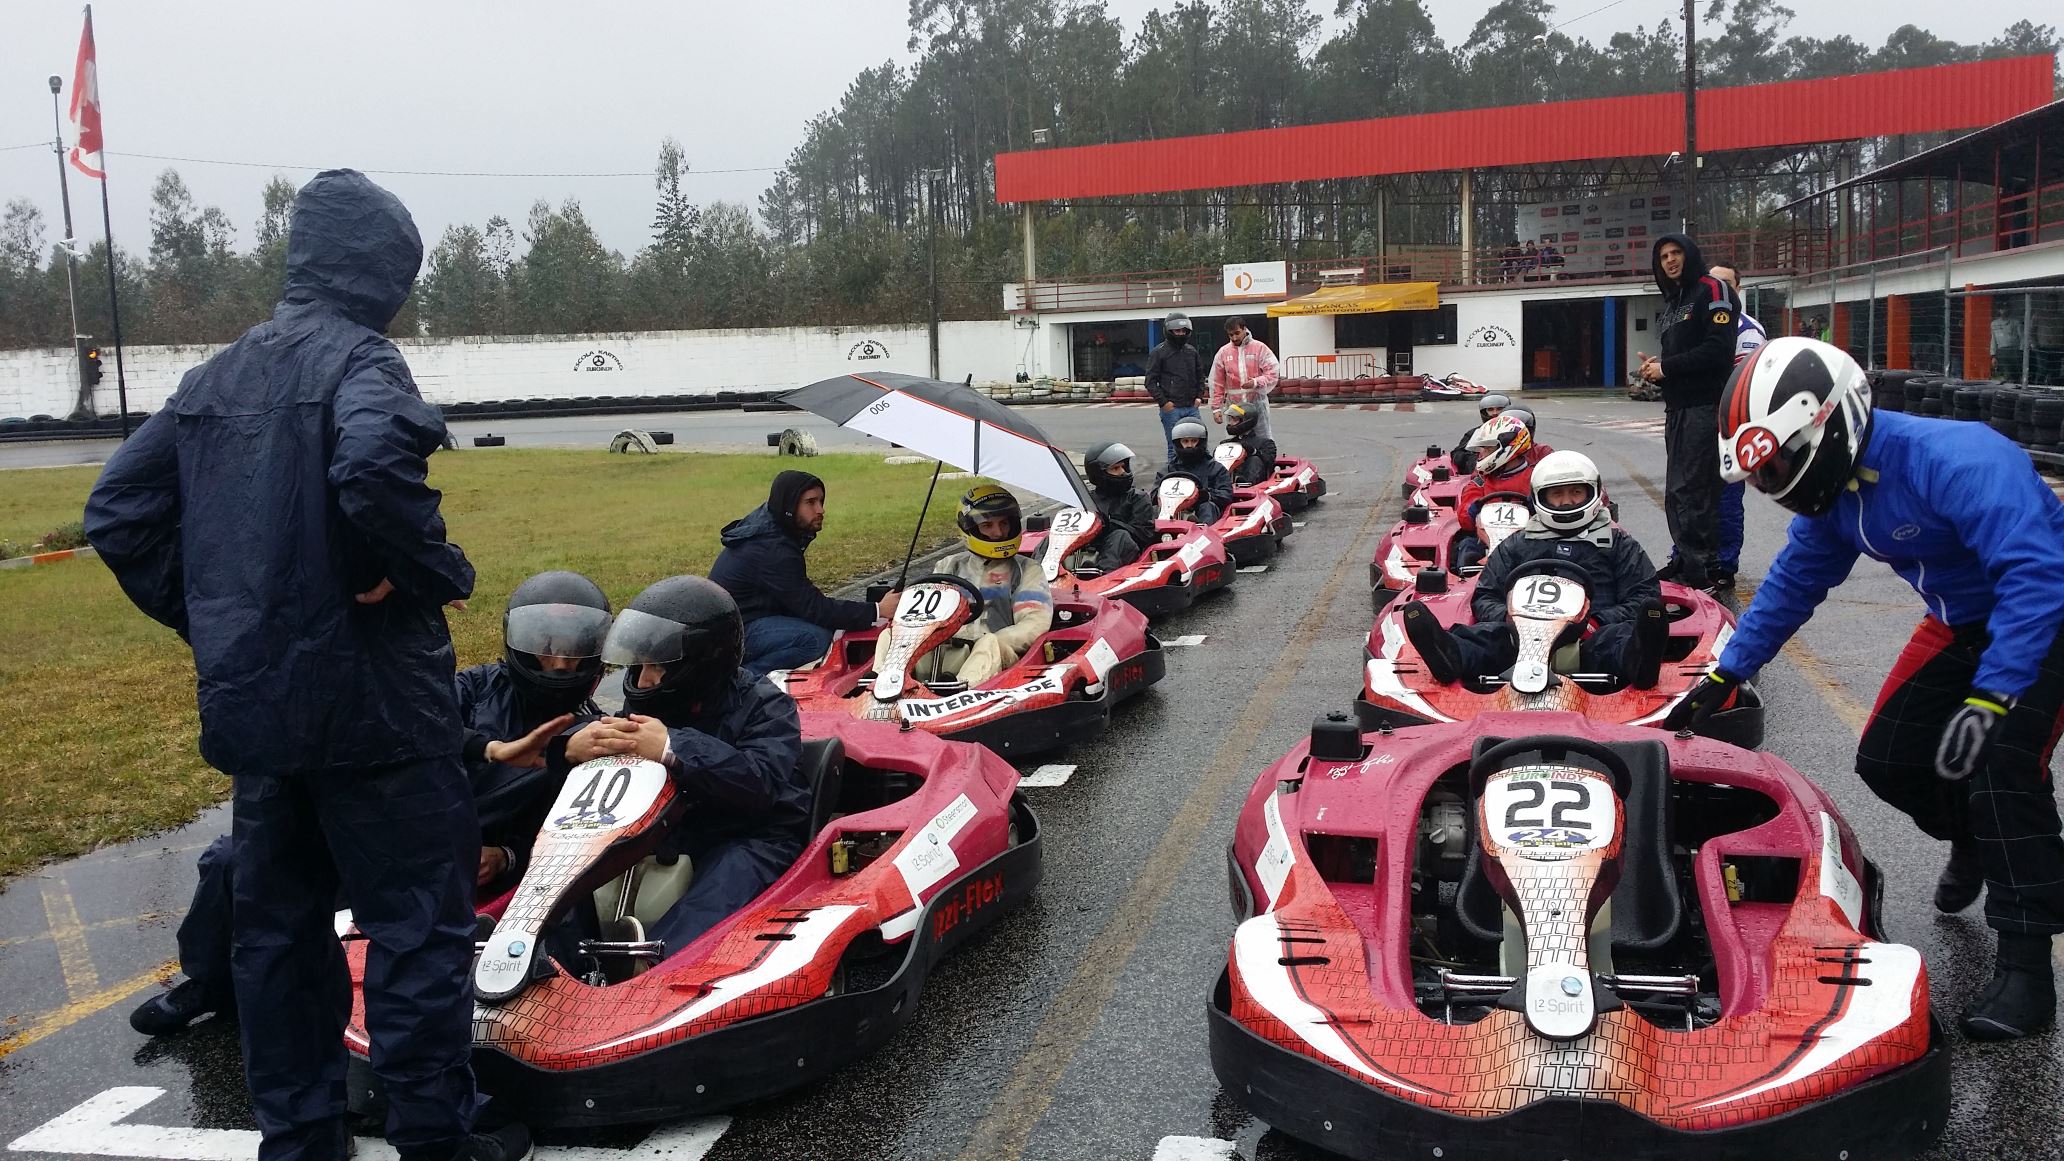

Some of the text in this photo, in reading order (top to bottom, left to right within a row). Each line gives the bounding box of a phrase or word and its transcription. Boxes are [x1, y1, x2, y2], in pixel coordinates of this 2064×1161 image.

[573, 349, 624, 371] ESCOLA KARTING
[1740, 430, 1774, 469] 25
[1171, 480, 1180, 493] 4
[1056, 511, 1083, 528] 32
[1494, 506, 1516, 523] 14
[906, 589, 942, 615] 20
[1525, 580, 1562, 605] 19
[906, 679, 1057, 717] INTERMDE
[1511, 771, 1588, 782] EUROINDY
[569, 767, 632, 817] 40
[1504, 780, 1592, 830] 22
[492, 959, 522, 974] Spirit
[1547, 999, 1585, 1016] Spirit
